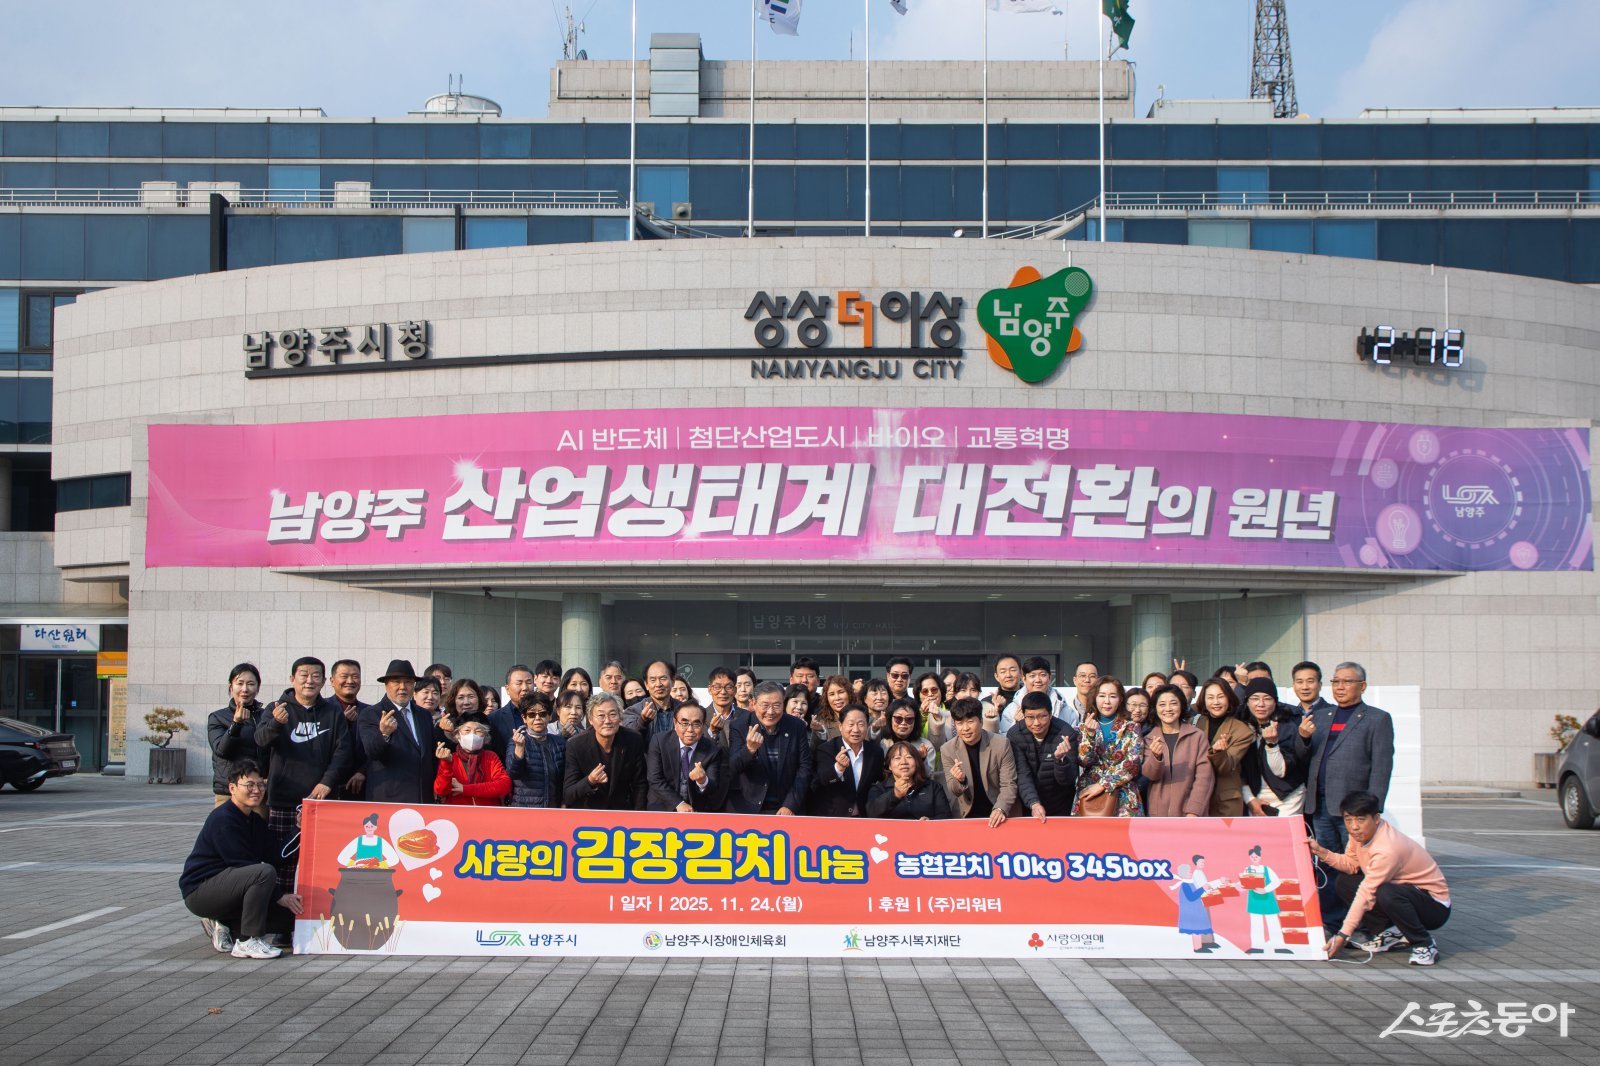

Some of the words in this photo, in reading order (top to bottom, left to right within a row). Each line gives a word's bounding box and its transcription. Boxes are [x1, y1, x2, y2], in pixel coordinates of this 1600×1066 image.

[993, 296, 1071, 357] 남양주
[242, 319, 430, 369] 남양주시청
[750, 359, 900, 379] NAMYANGJU
[913, 359, 963, 379] CITY
[556, 428, 584, 451] AI
[591, 427, 669, 451] 반도체
[688, 426, 846, 450] 첨단산업도시
[867, 426, 947, 450] 바이오
[966, 426, 1071, 451] 교통혁명
[266, 488, 427, 543] 남양주
[441, 461, 877, 540] 산업생태계
[893, 462, 1213, 540] 대전환의
[1228, 487, 1337, 541] 원년
[1454, 506, 1486, 518] 남양주
[456, 840, 565, 880] 사랑의
[574, 827, 789, 883] 김장김치
[796, 846, 867, 883] 나눔
[896, 852, 992, 878] 농협김치
[995, 852, 1063, 881] 10kg
[1067, 853, 1173, 880] 345box
[620, 895, 652, 912] 일자
[669, 896, 713, 912] 2025.
[720, 897, 744, 912] 11.
[750, 895, 803, 913] 24.(월)
[878, 896, 910, 913] 후원
[927, 896, 1002, 913] (주)리워터
[528, 933, 578, 947] 남양주시
[664, 934, 787, 947] 남양주시장애인체육회
[864, 934, 962, 947] 남양주시복지재단
[1046, 933, 1105, 946] 사랑의열매
